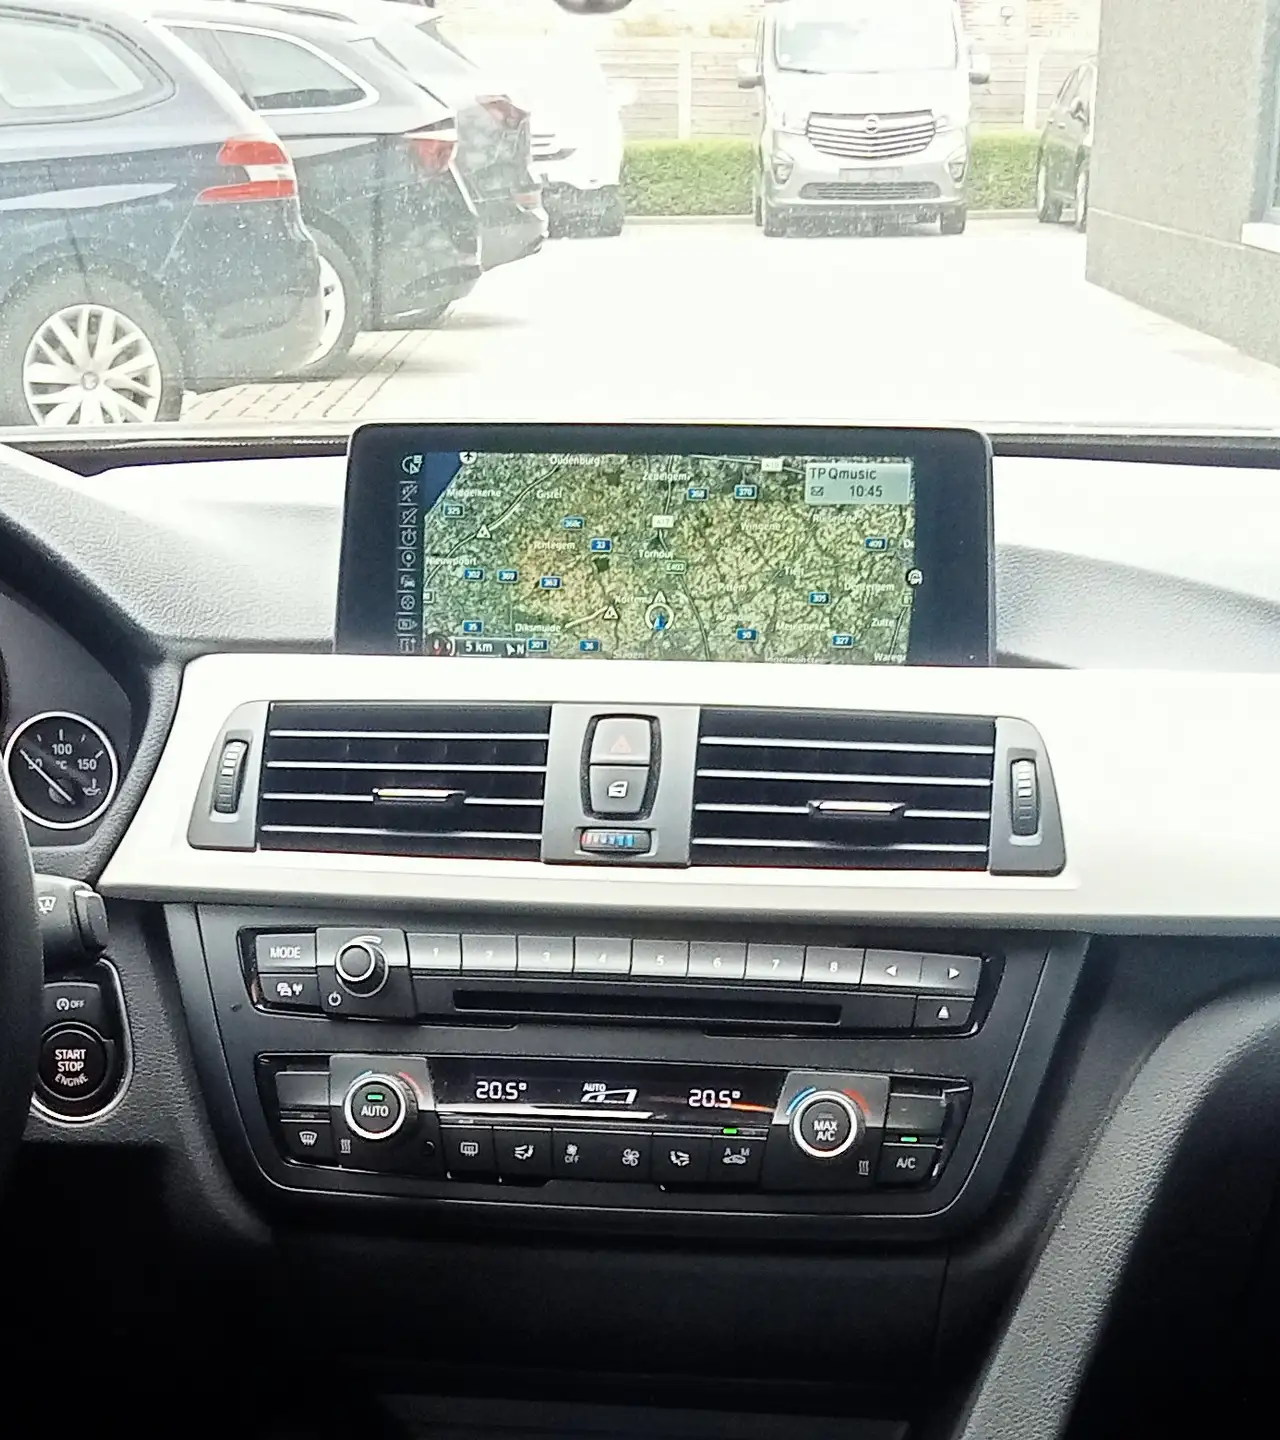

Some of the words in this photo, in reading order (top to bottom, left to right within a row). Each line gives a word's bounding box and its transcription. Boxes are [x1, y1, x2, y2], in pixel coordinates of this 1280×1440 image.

[810, 467, 827, 480] TP
[828, 467, 877, 481] Qmusic
[849, 485, 884, 498] 10:45
[465, 641, 473, 652] 5
[475, 641, 494, 653] km
[51, 743, 73, 756] 100
[77, 757, 97, 770] 150
[270, 946, 302, 960] MODE
[541, 951, 552, 963] 3
[597, 952, 608, 964] 4
[655, 954, 666, 966] 5
[712, 956, 722, 969] 6
[771, 959, 781, 972] 7
[829, 961, 839, 973] 8
[70, 1000, 85, 1009] OFF
[55, 1049, 87, 1060] START
[57, 1061, 84, 1072] STOP
[54, 1073, 89, 1087] ENGINE
[583, 1082, 607, 1092] AUTO
[360, 1104, 389, 1118] AUTO
[813, 1119, 838, 1131] MAX
[816, 1130, 836, 1142] A/C
[895, 1157, 917, 1170] A/C
